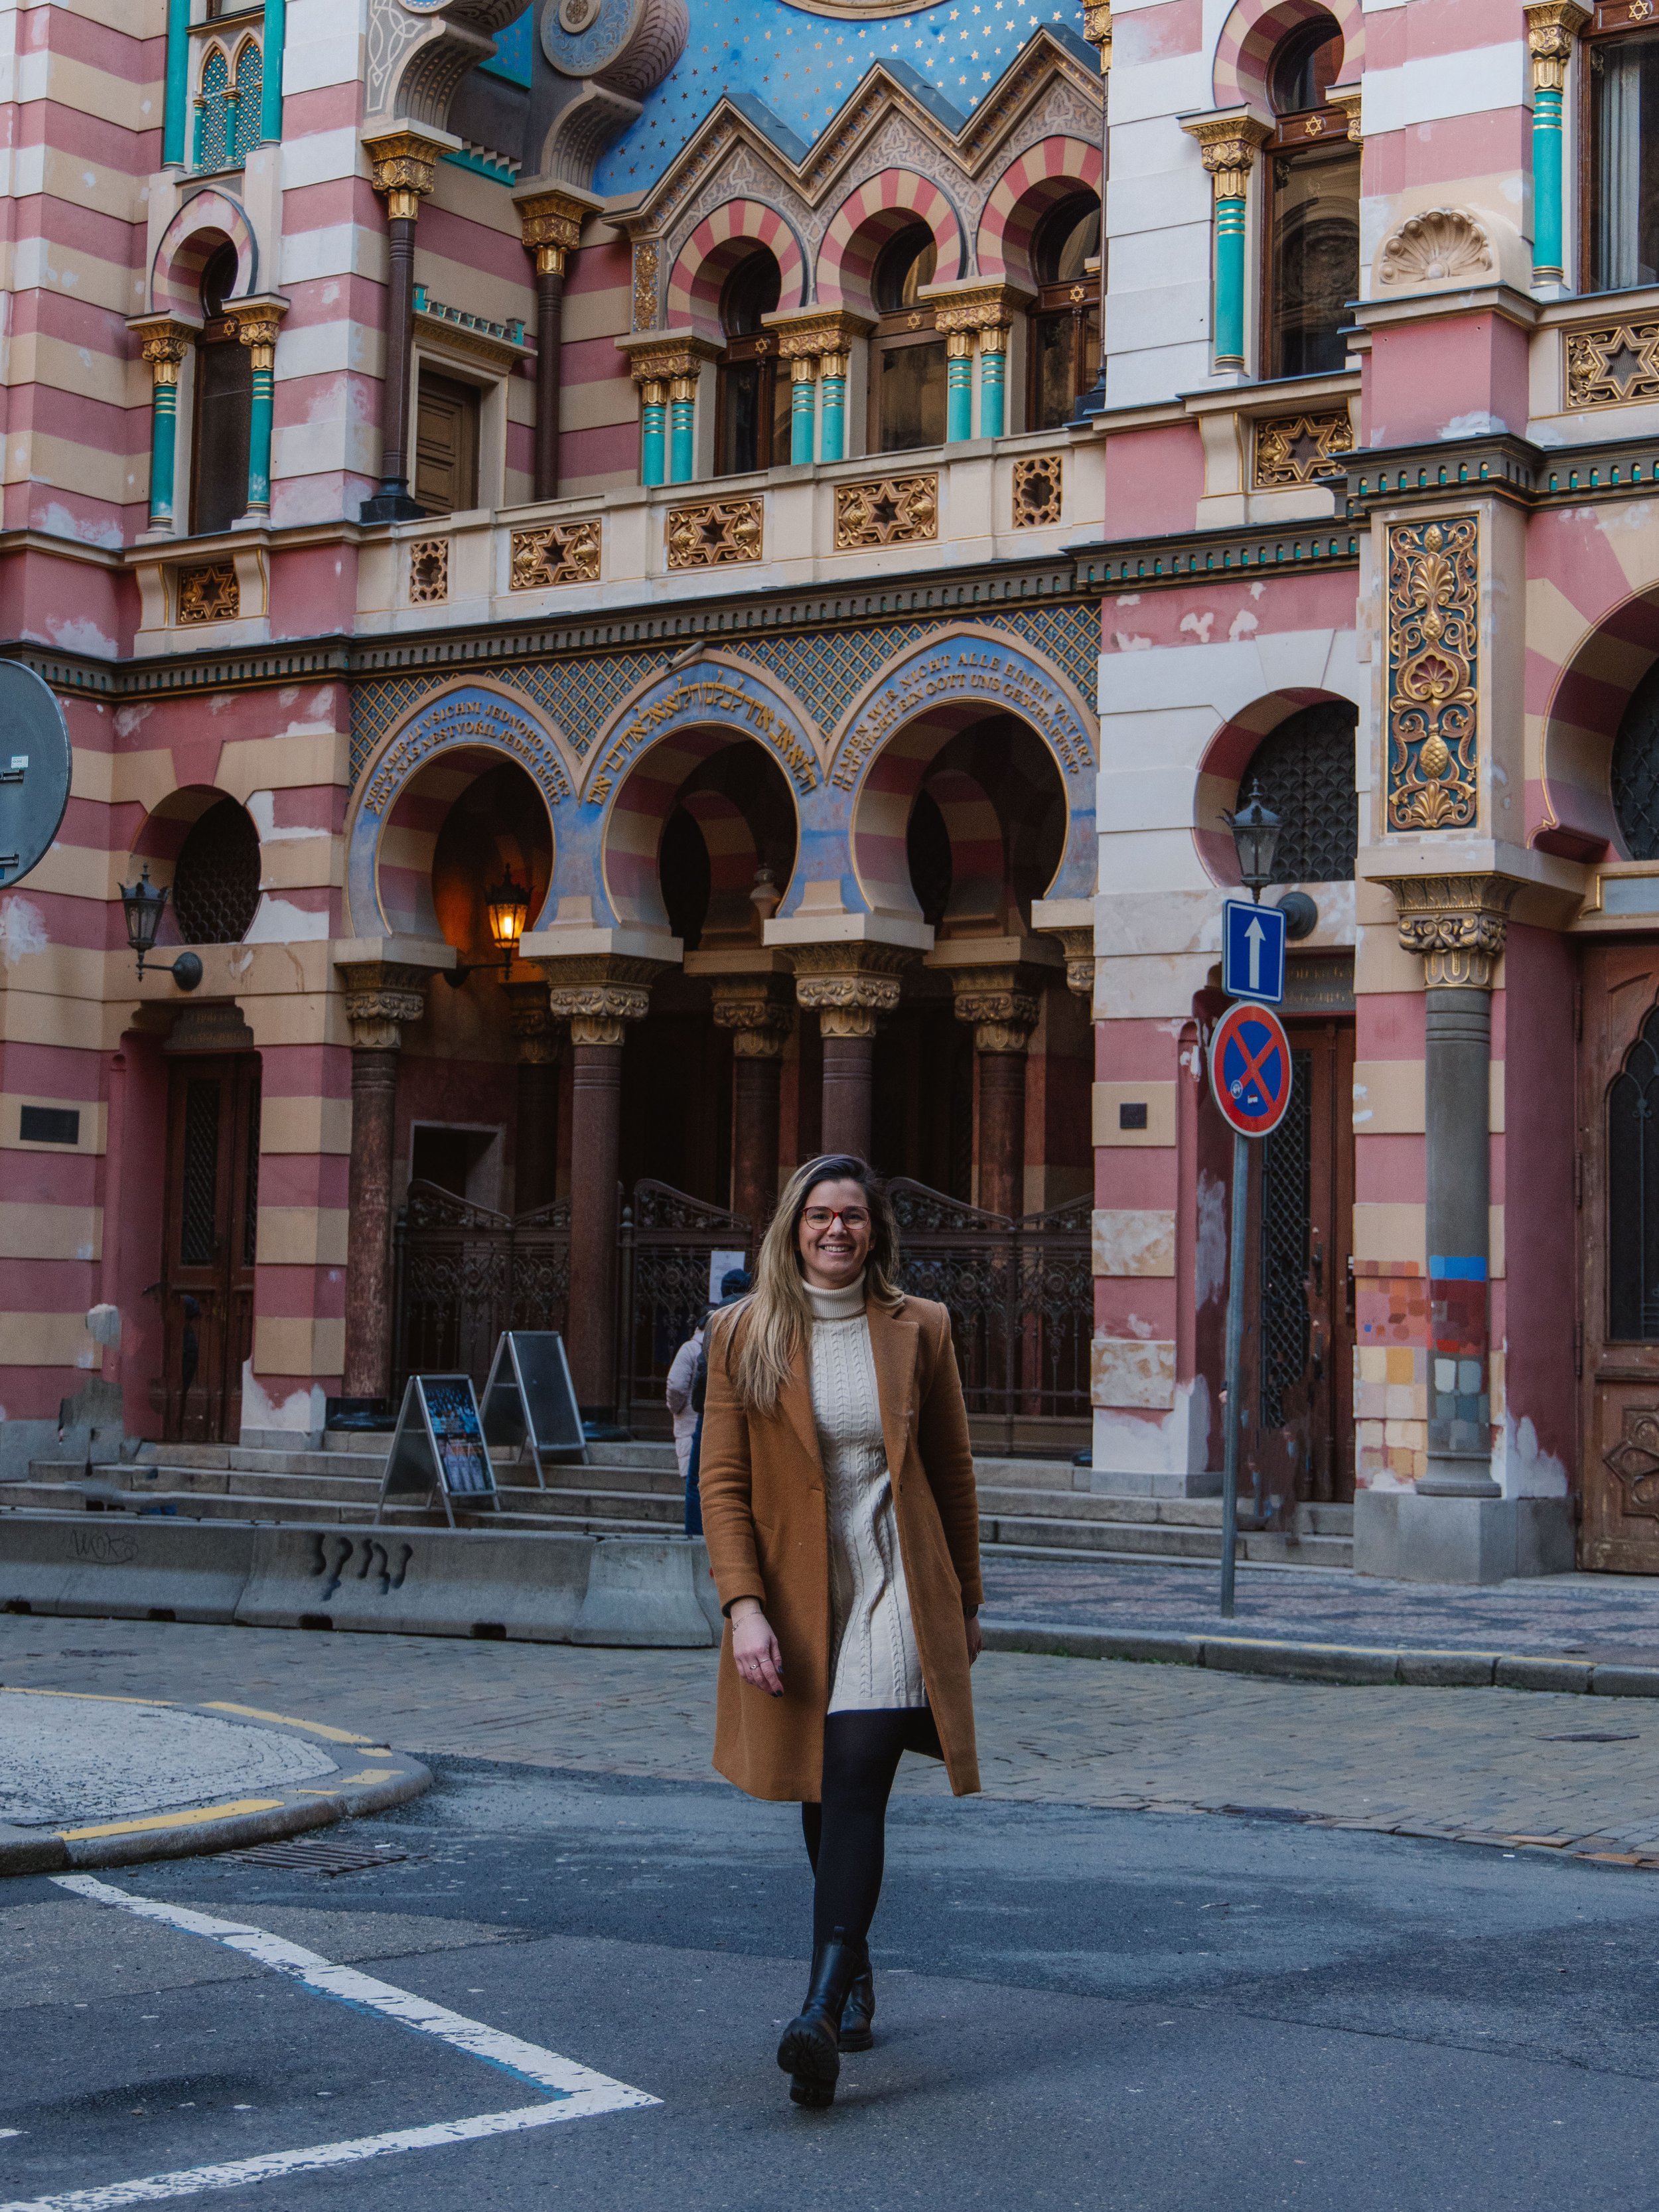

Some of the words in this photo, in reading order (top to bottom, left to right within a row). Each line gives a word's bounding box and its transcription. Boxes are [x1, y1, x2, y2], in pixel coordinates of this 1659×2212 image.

[421, 719, 496, 751] NESTVOŘIL
[499, 730, 539, 765] JEDEN
[536, 764, 561, 804] BŮH?
[422, 701, 482, 728] VŠICHNI
[484, 704, 544, 750] JEDNOHO
[543, 750, 571, 796] OTCE?
[831, 722, 868, 786] HABEN
[867, 689, 899, 720] WIR
[899, 654, 950, 690] NICHT
[958, 652, 1001, 671] ALLE
[1003, 663, 1053, 702] EINEN
[1054, 702, 1093, 766] VATER?
[841, 755, 863, 792] HAT
[859, 708, 898, 756] NICHT
[898, 688, 924, 713] EIN
[925, 674, 966, 695] GOTT
[970, 674, 1001, 691] UNS
[1003, 684, 1080, 774] GESCHAFFEN?
